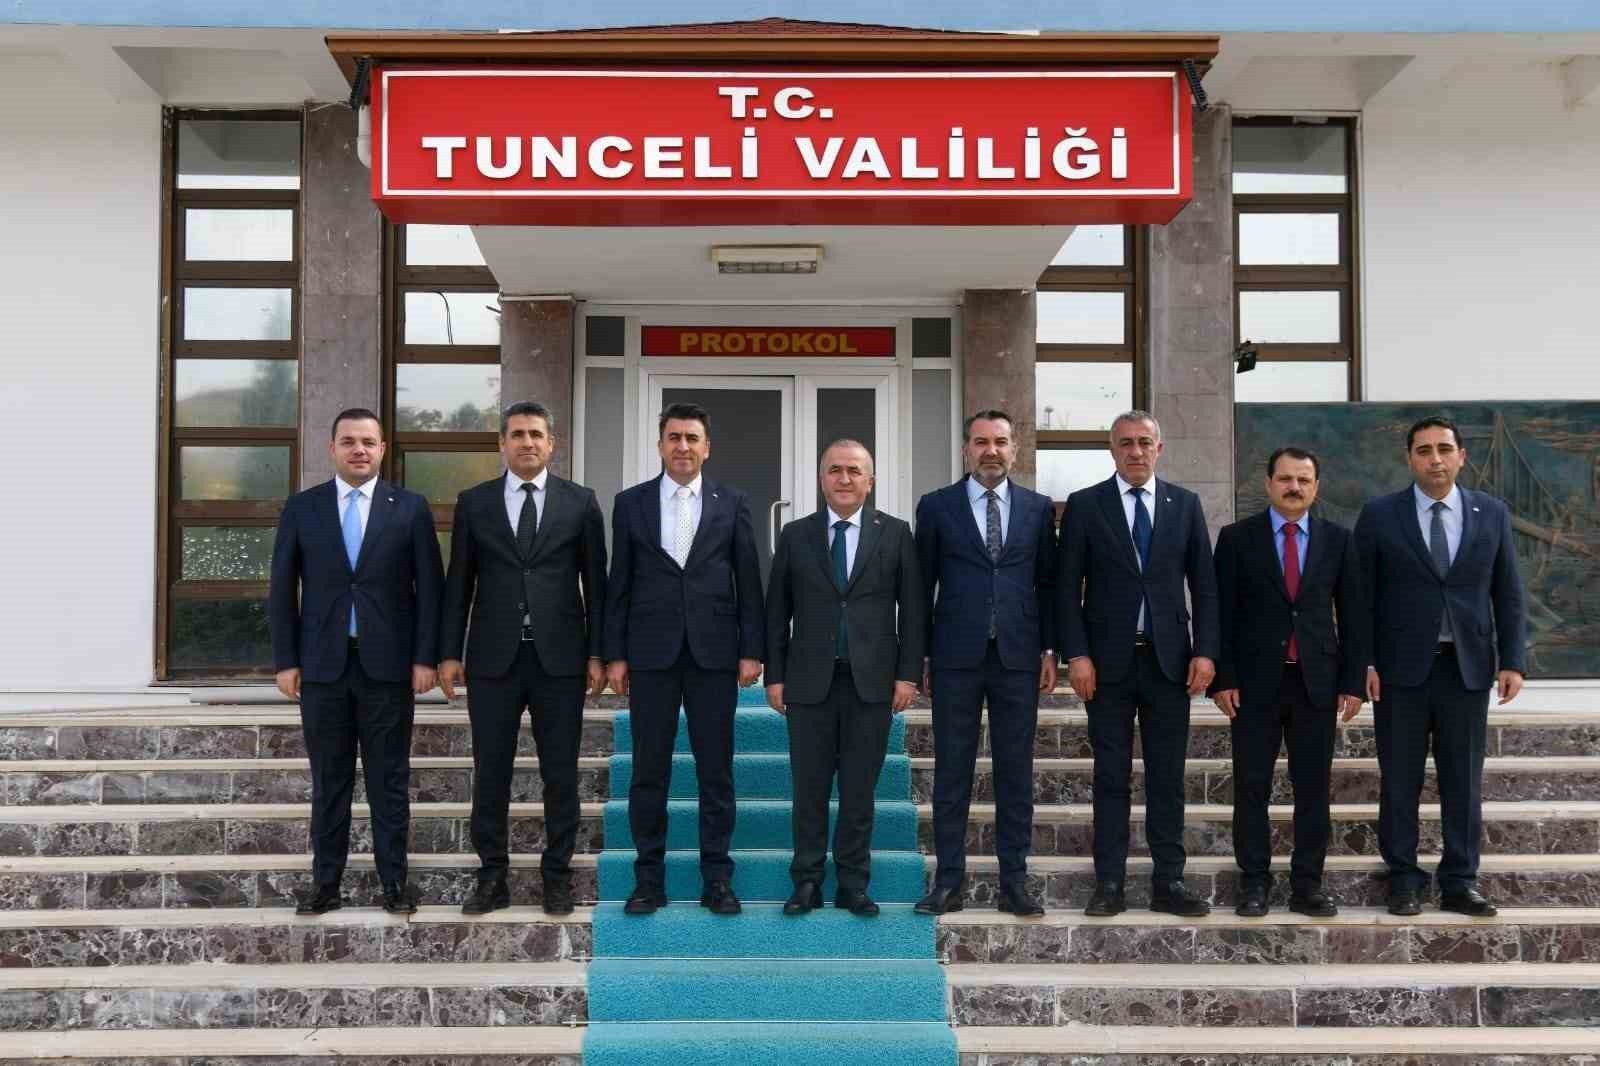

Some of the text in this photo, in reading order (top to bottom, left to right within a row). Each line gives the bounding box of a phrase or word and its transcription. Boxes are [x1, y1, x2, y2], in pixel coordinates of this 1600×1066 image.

[718, 86, 835, 120] T.C.
[421, 126, 1129, 181] TUNCELİ VALİLİĞİ
[679, 332, 859, 354] PROTOKOL
